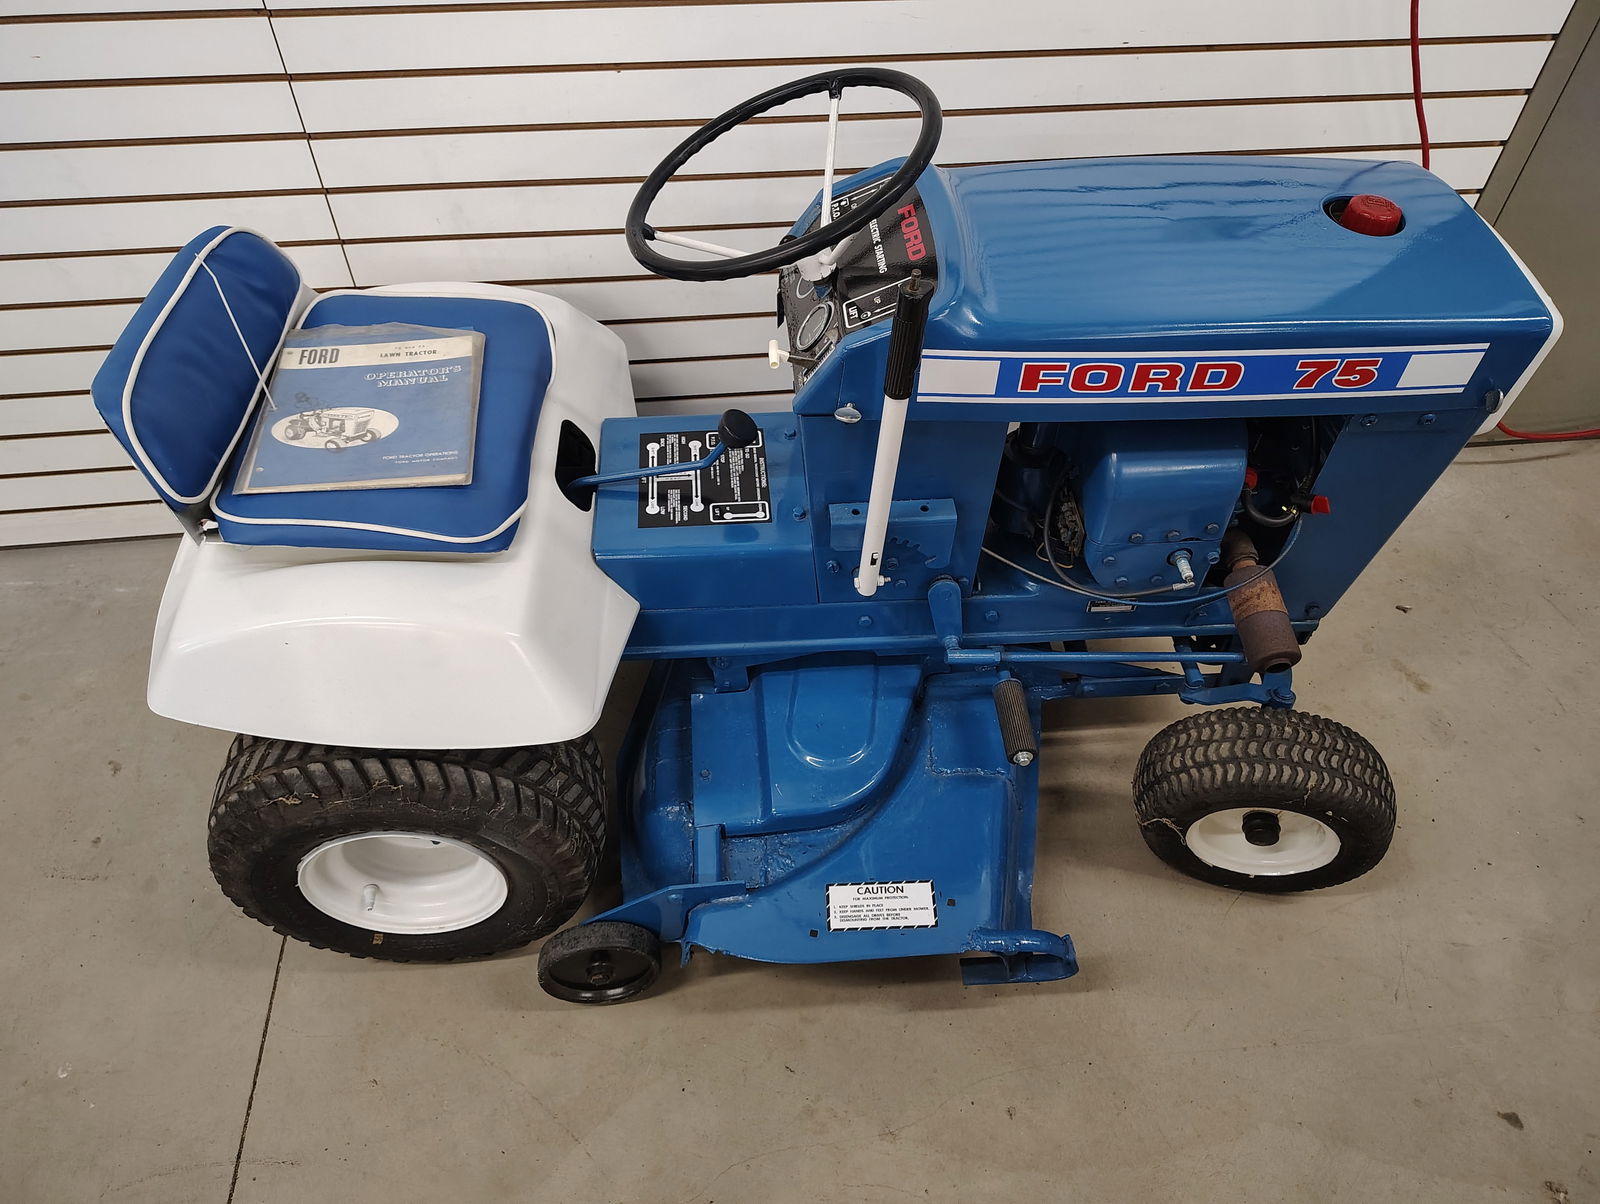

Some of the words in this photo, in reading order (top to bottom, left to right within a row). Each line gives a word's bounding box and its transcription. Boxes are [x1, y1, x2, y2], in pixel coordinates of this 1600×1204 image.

[868, 219, 881, 246] ELECTRIC
[898, 204, 926, 261] FORD
[874, 244, 887, 274] STARTING
[848, 306, 858, 319] LIFT
[298, 348, 340, 366] FORD
[365, 365, 462, 380] OPERATOR'S
[377, 374, 449, 388] MANUAL
[1016, 361, 1246, 394] FORD
[1292, 358, 1382, 390] 75
[857, 886, 904, 895] CAUTION
